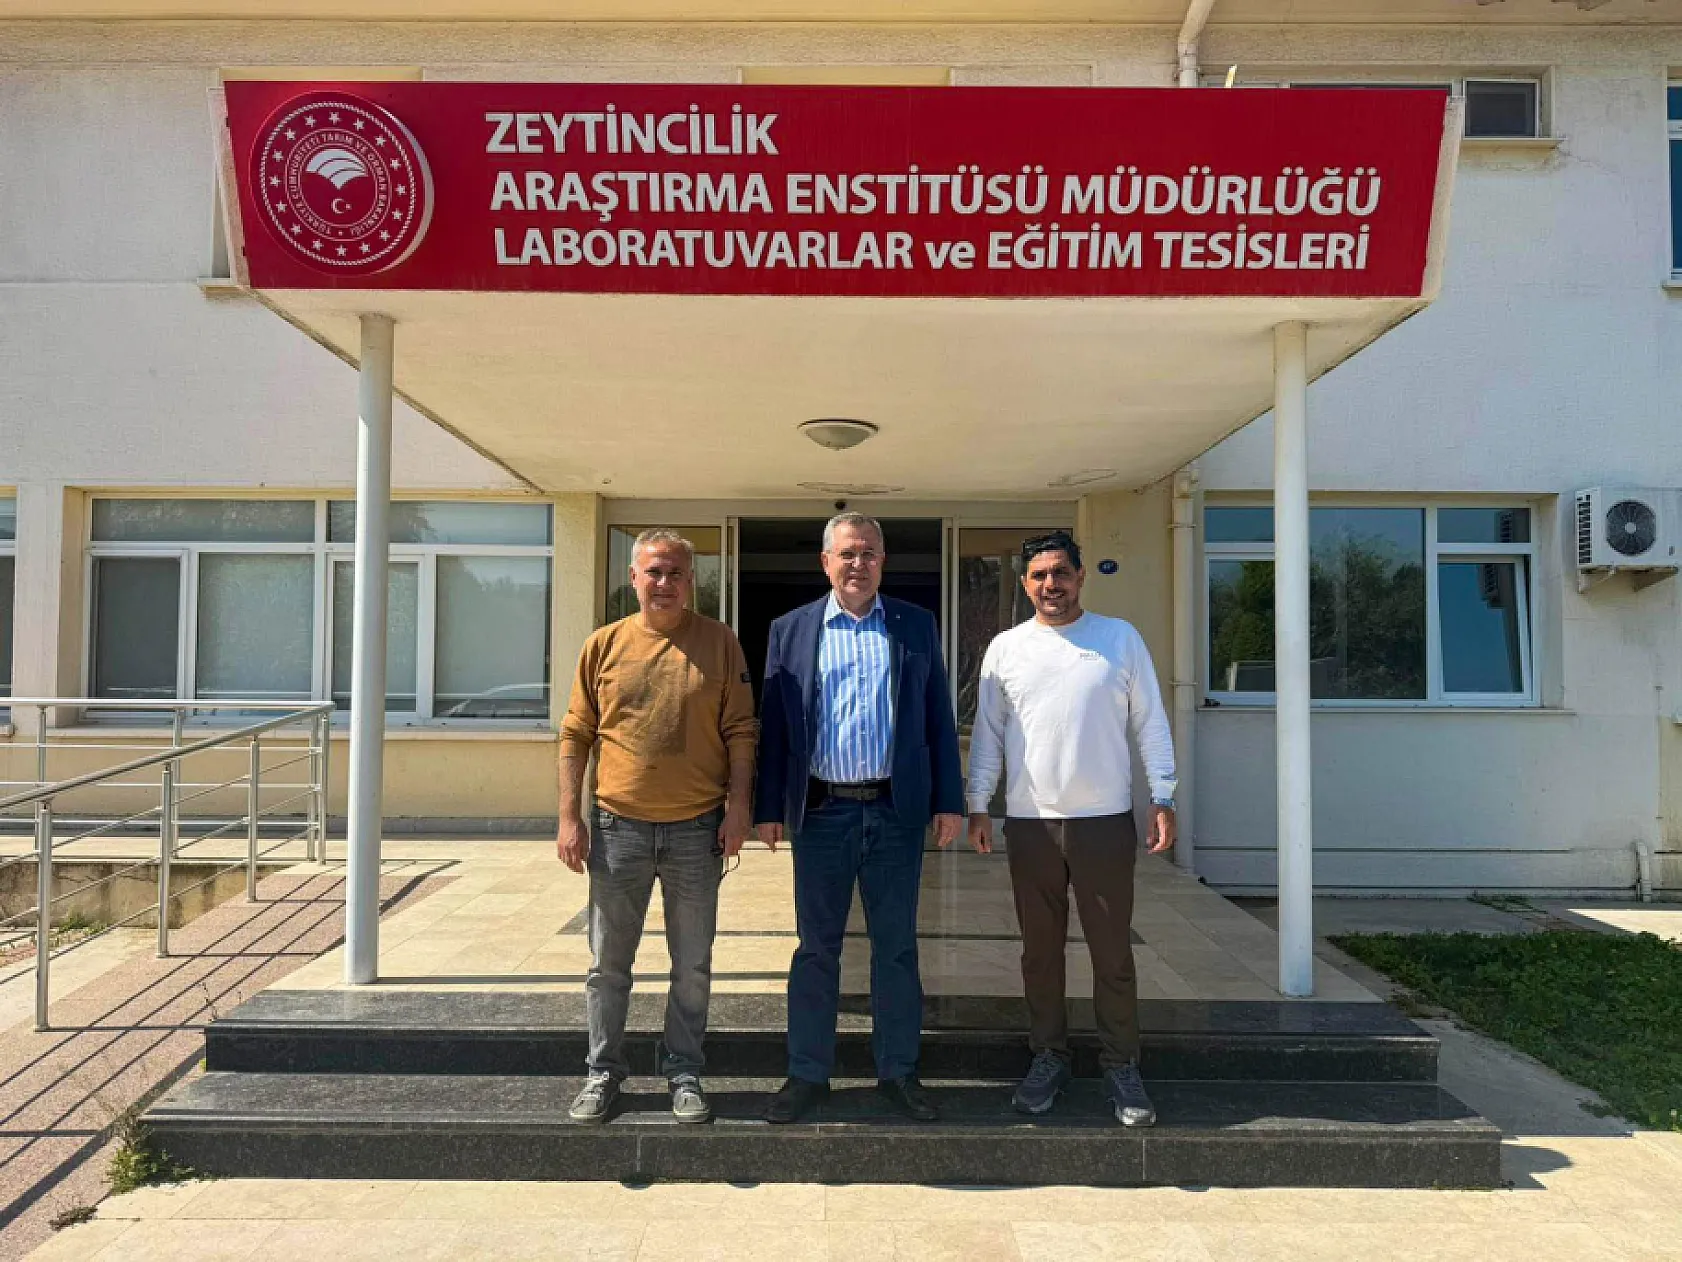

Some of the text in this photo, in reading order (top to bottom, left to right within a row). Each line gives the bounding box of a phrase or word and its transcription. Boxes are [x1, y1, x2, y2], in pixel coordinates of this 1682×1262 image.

[485, 104, 779, 155] ZEYTİNCİLİK
[490, 165, 1381, 222] ARAŞTIRMA ENSTİTÜSÜ MÜDÜRLÜĞÜ
[494, 222, 1370, 270] LABORATUVARLAR ve EĞİTİM TESİSLERİ
